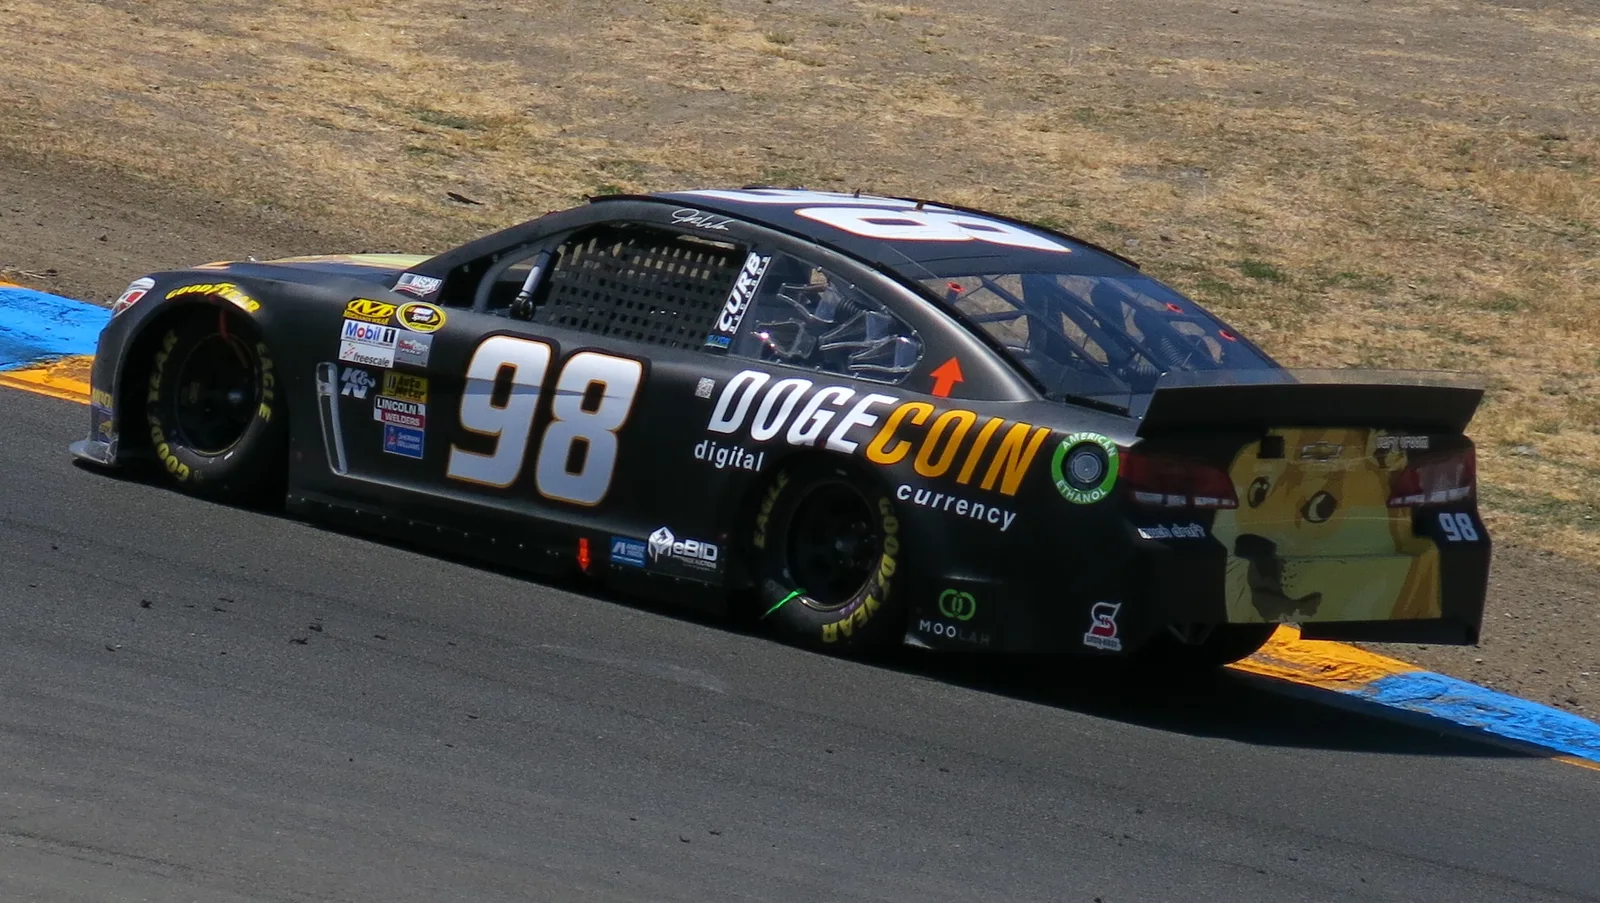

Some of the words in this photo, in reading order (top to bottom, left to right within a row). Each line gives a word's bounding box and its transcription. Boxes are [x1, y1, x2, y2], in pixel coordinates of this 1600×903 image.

[719, 252, 761, 331] CURB
[346, 321, 382, 342] Mobil
[353, 352, 390, 367] freescale
[376, 398, 418, 415] LINCOLN
[384, 412, 420, 427] WELDERS
[446, 334, 644, 507] 98
[707, 370, 1053, 497] DOGECOIN
[694, 440, 765, 472] digital
[1062, 432, 1116, 457] AMERICAN
[1056, 479, 1108, 503] ETHANOL
[896, 484, 1017, 532] currency
[1438, 512, 1479, 542] 98
